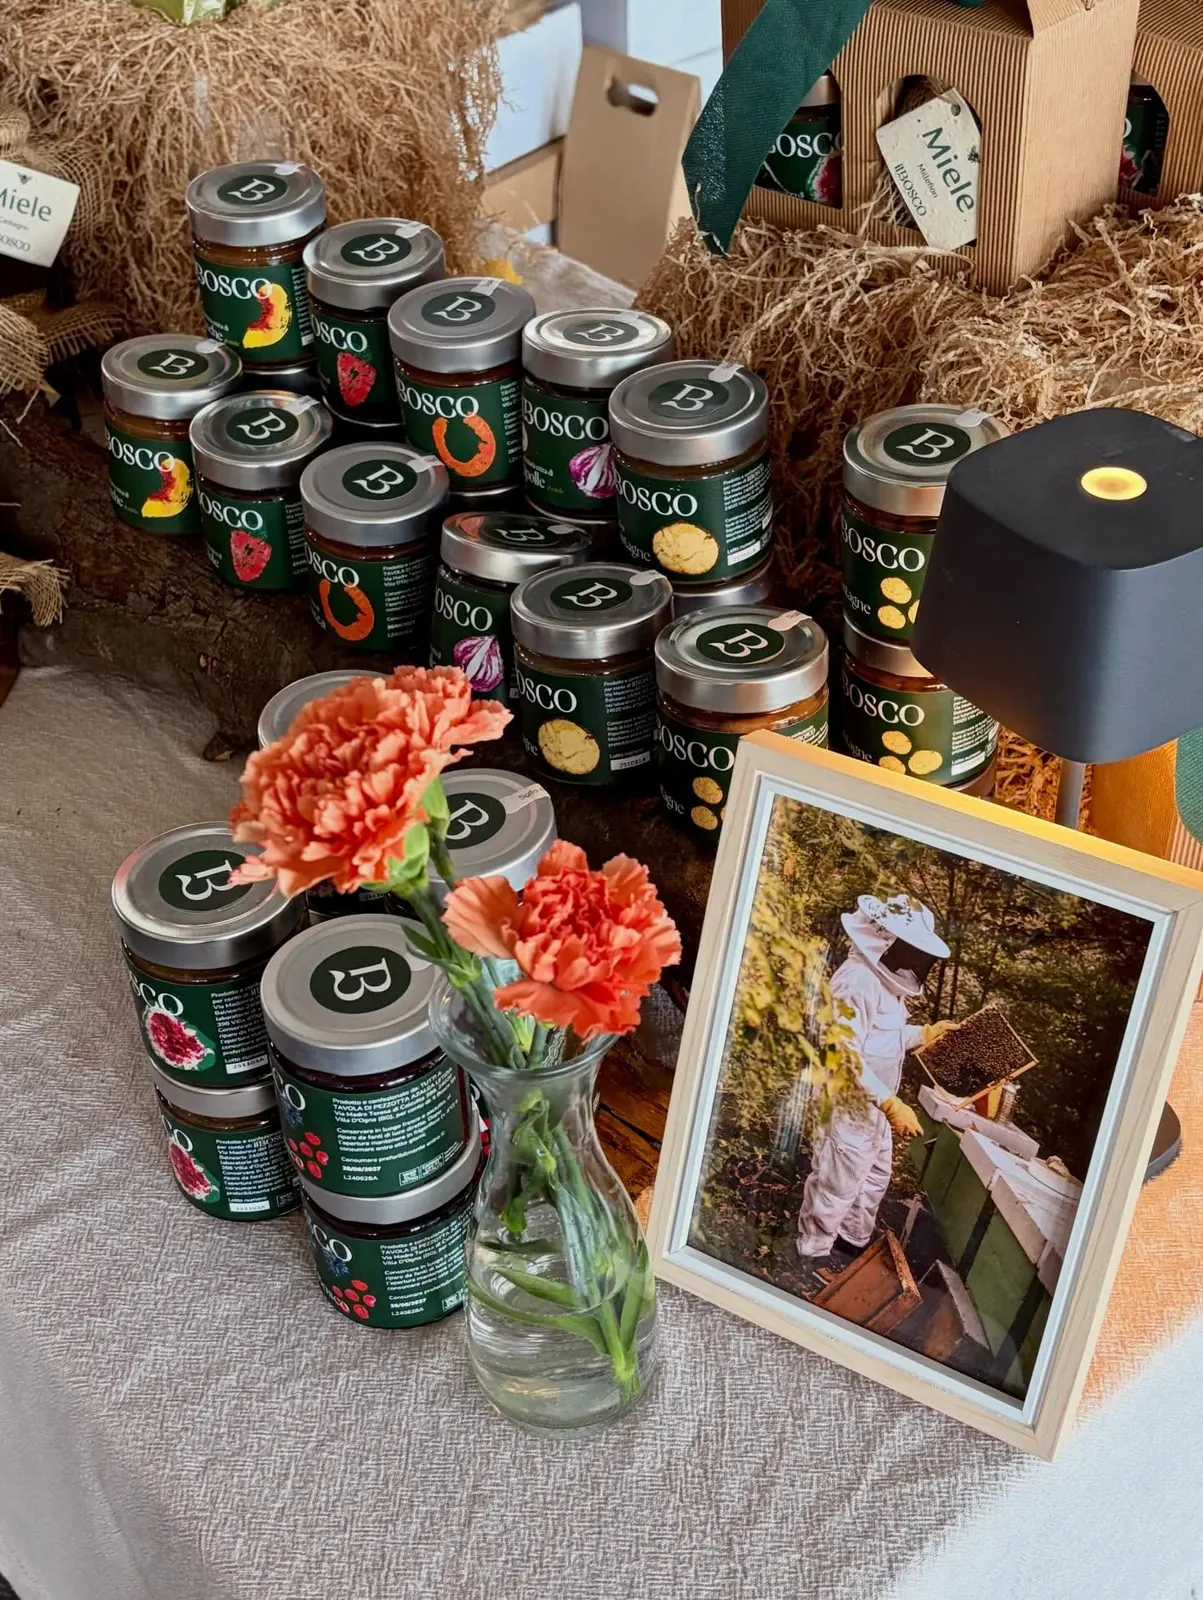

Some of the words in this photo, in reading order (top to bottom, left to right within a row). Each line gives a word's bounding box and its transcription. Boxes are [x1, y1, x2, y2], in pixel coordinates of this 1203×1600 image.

[769, 131, 841, 158] OSC
[922, 127, 975, 214] Miele
[227, 178, 276, 201] B
[917, 163, 938, 199] Millefiori
[0, 234, 31, 252] OSCO
[351, 237, 400, 262] B
[432, 295, 482, 322] B
[573, 323, 625, 342] B
[148, 352, 196, 376] B
[661, 383, 714, 412] B
[236, 411, 286, 440] B
[523, 400, 609, 441] BOSCO
[896, 428, 955, 459] B
[352, 464, 404, 495] B
[561, 581, 618, 608] B
[708, 628, 769, 658] B
[328, 957, 392, 1002] B
[210, 990, 238, 998] Prodotto
[333, 1104, 363, 1112] TAVOLA
[364, 1103, 372, 1111] DI
[373, 1096, 410, 1110] PEZZOTTA
[368, 1090, 409, 1104] confezionato
[368, 1108, 391, 1116] Teresa
[396, 1111, 406, 1119] per
[382, 1124, 401, 1133] luogo
[402, 1116, 421, 1126] fresco
[391, 1129, 406, 1137] luce
[370, 1135, 405, 1146] mantenere
[394, 1140, 408, 1148] otto
[378, 1144, 426, 1163] preferibilmente
[381, 1247, 409, 1255] TAVOLA
[414, 1245, 435, 1255] Teresa
[398, 1255, 422, 1264] D'Ogna
[384, 1266, 420, 1276] Conservare
[413, 1269, 428, 1277] fonti
[387, 1282, 420, 1291] consumare
[388, 1291, 424, 1300] Consumare
